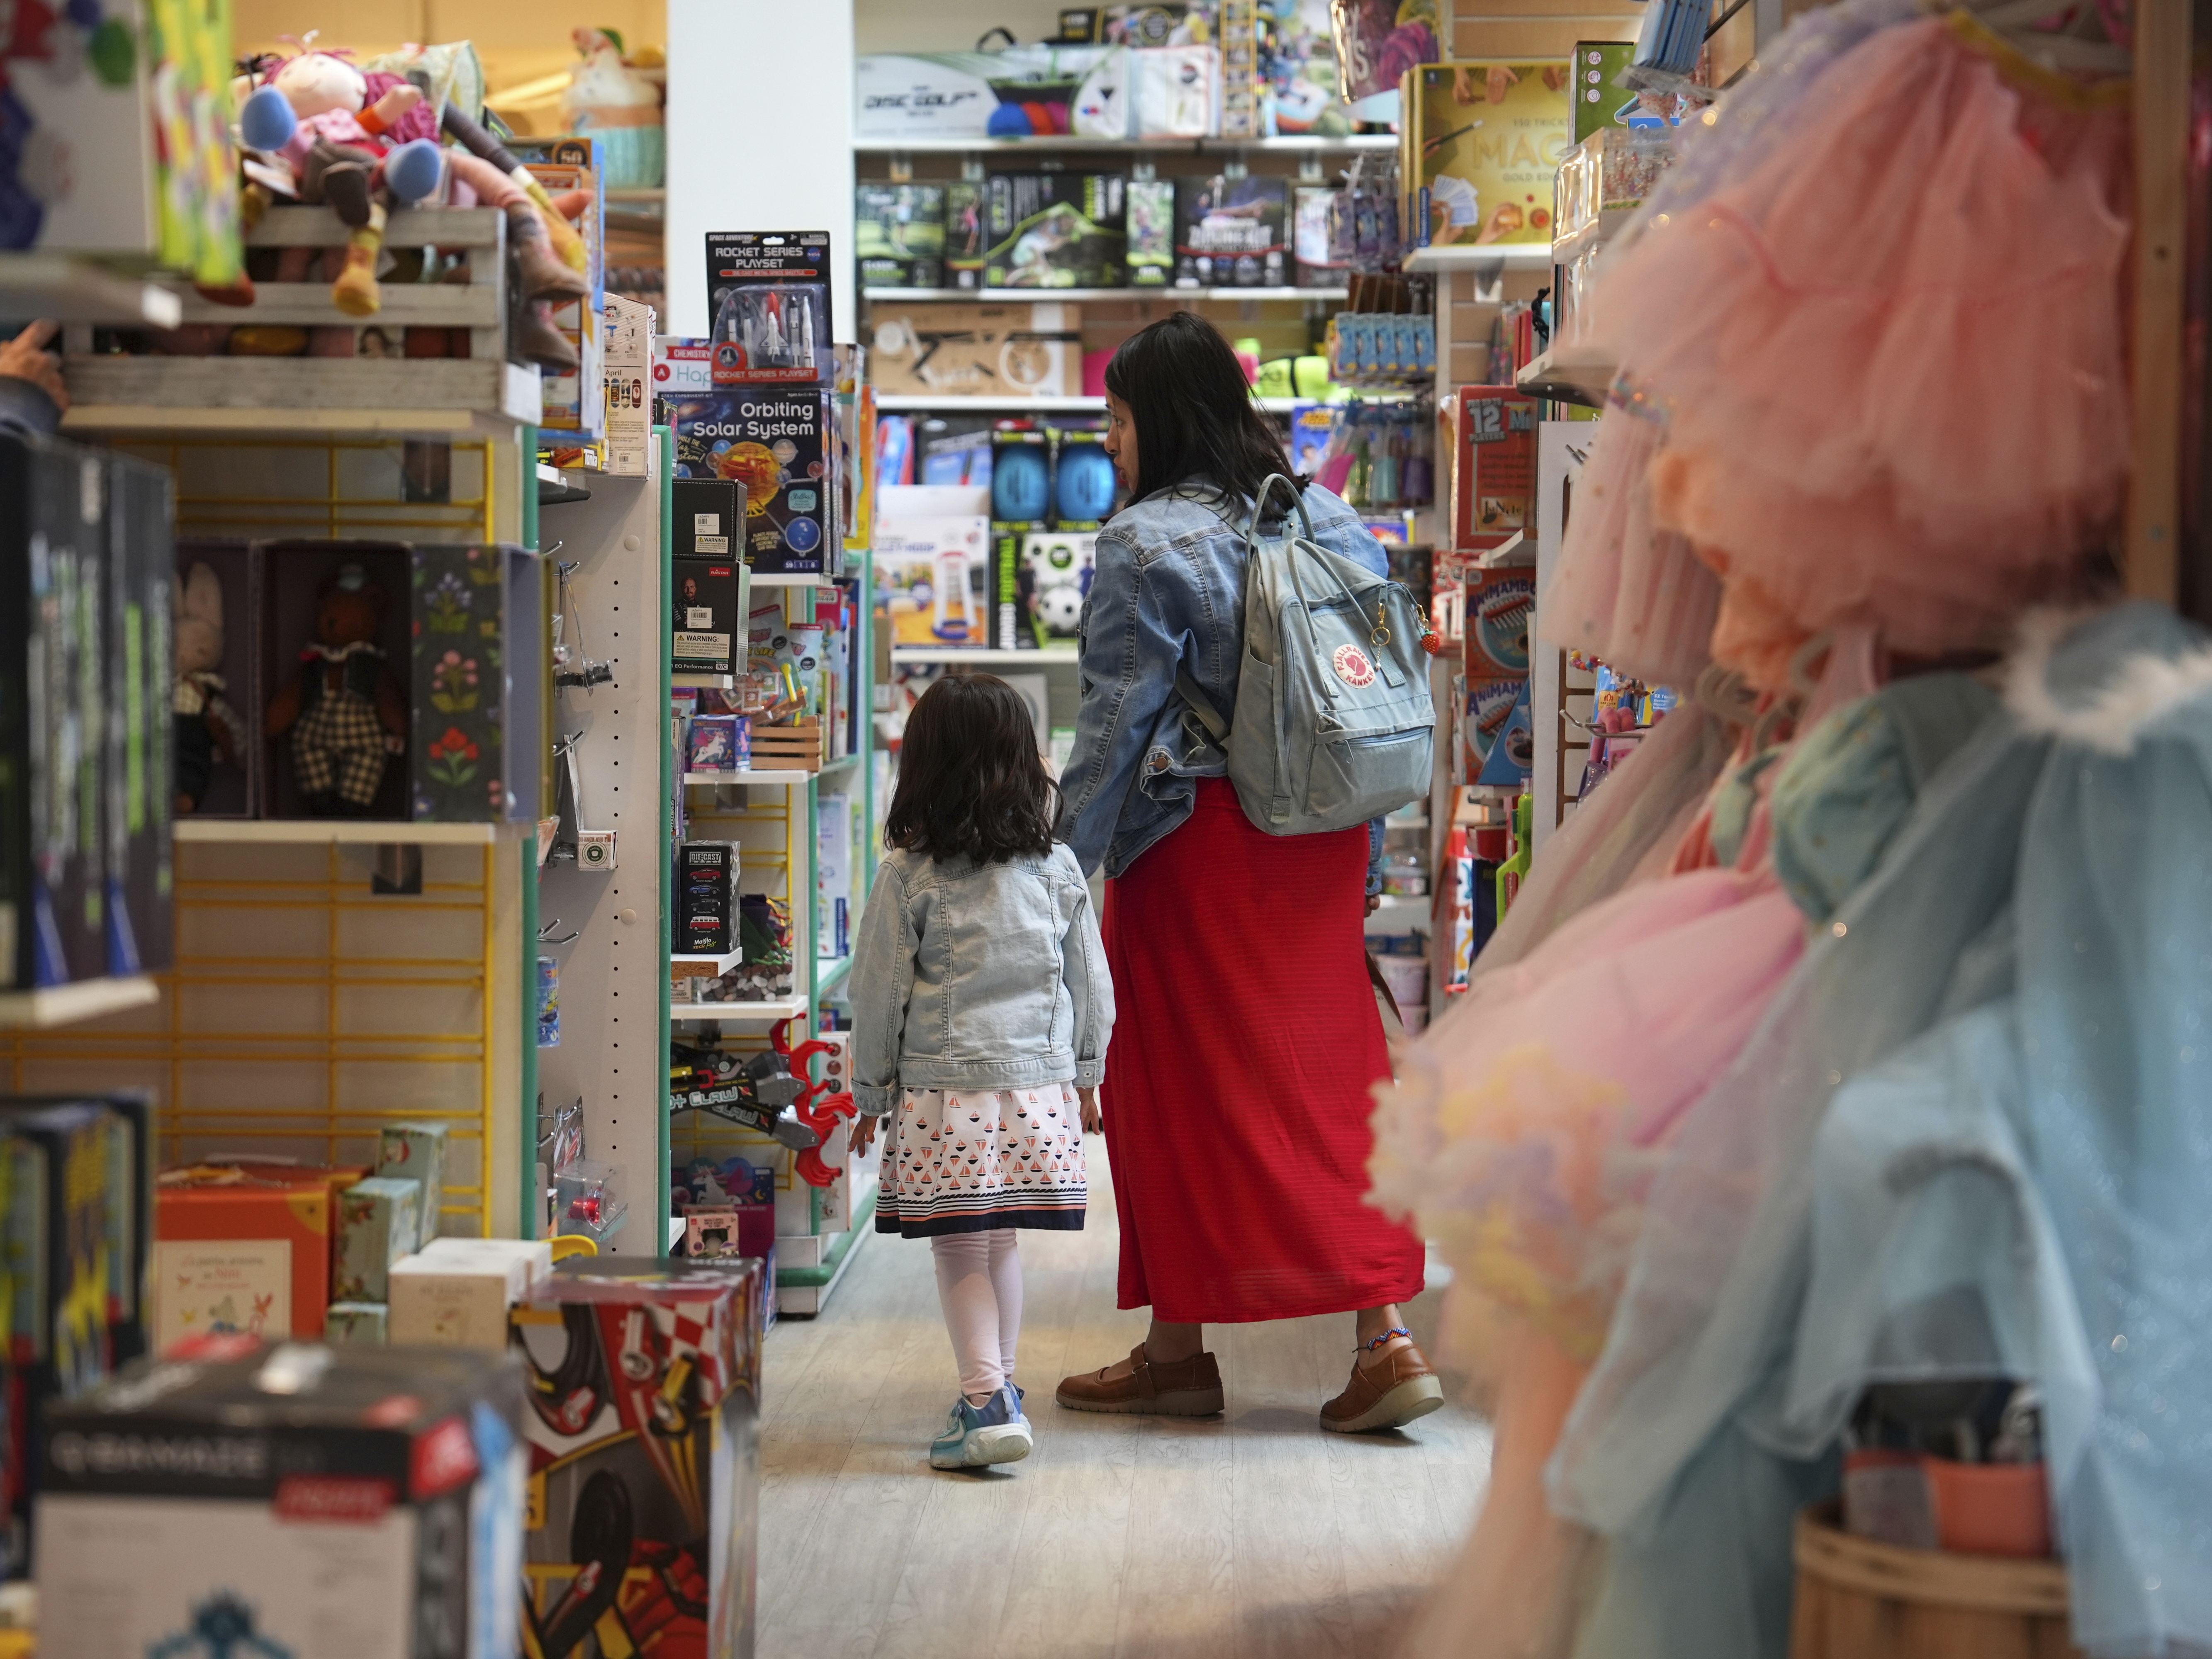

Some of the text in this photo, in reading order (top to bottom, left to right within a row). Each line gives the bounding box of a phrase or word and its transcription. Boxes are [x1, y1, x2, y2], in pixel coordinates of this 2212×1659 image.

[715, 246, 804, 257] ROCKET SERIES
[735, 258, 784, 269] PLAYSET
[740, 402, 814, 421] Orbiting
[1468, 404, 1501, 433] 12
[694, 421, 814, 439] Solar System
[691, 853, 720, 861] DIE-CAST
[694, 937, 712, 945] Maisto
[689, 1086, 738, 1107] CLAW
